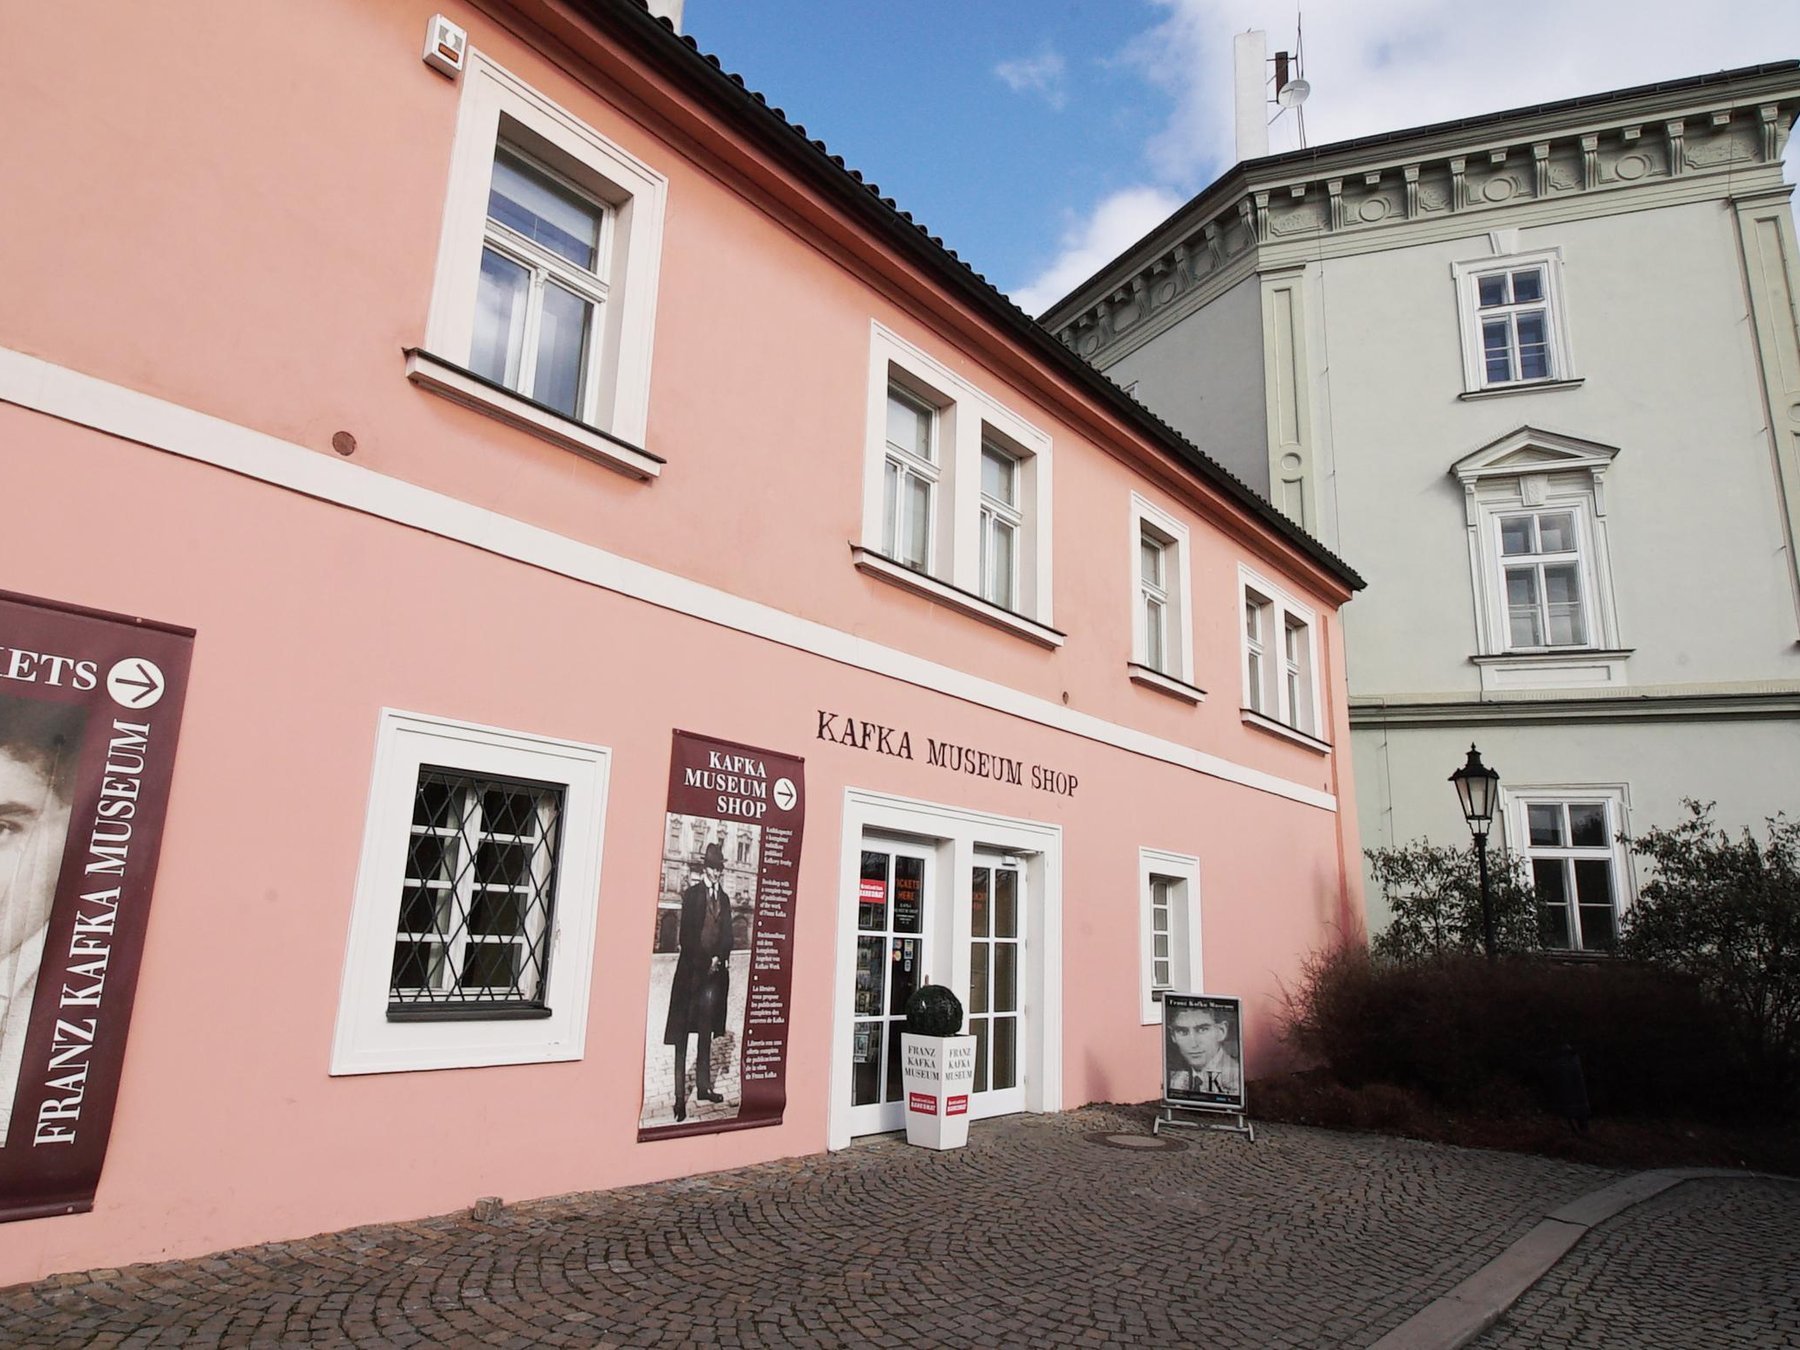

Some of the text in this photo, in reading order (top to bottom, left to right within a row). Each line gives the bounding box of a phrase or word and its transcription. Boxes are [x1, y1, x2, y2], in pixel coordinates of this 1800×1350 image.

[0, 646, 98, 690] ETS
[816, 710, 1079, 798] KAFKA MUSEUM SHOP
[709, 751, 767, 778] KAFKA
[684, 768, 767, 798] MUSEUM
[717, 795, 767, 818] SHOP
[33, 718, 150, 1148] FRANZ KAFKA MUSEUM
[1169, 999, 1187, 1007] Franz
[908, 1045, 936, 1057] FRANZ
[949, 1048, 971, 1058] FRANZ
[907, 1057, 936, 1069] KAFKA
[948, 1059, 971, 1069] KAFKA
[905, 1068, 939, 1080] MUSEUM
[945, 1070, 972, 1081] MUSEUM
